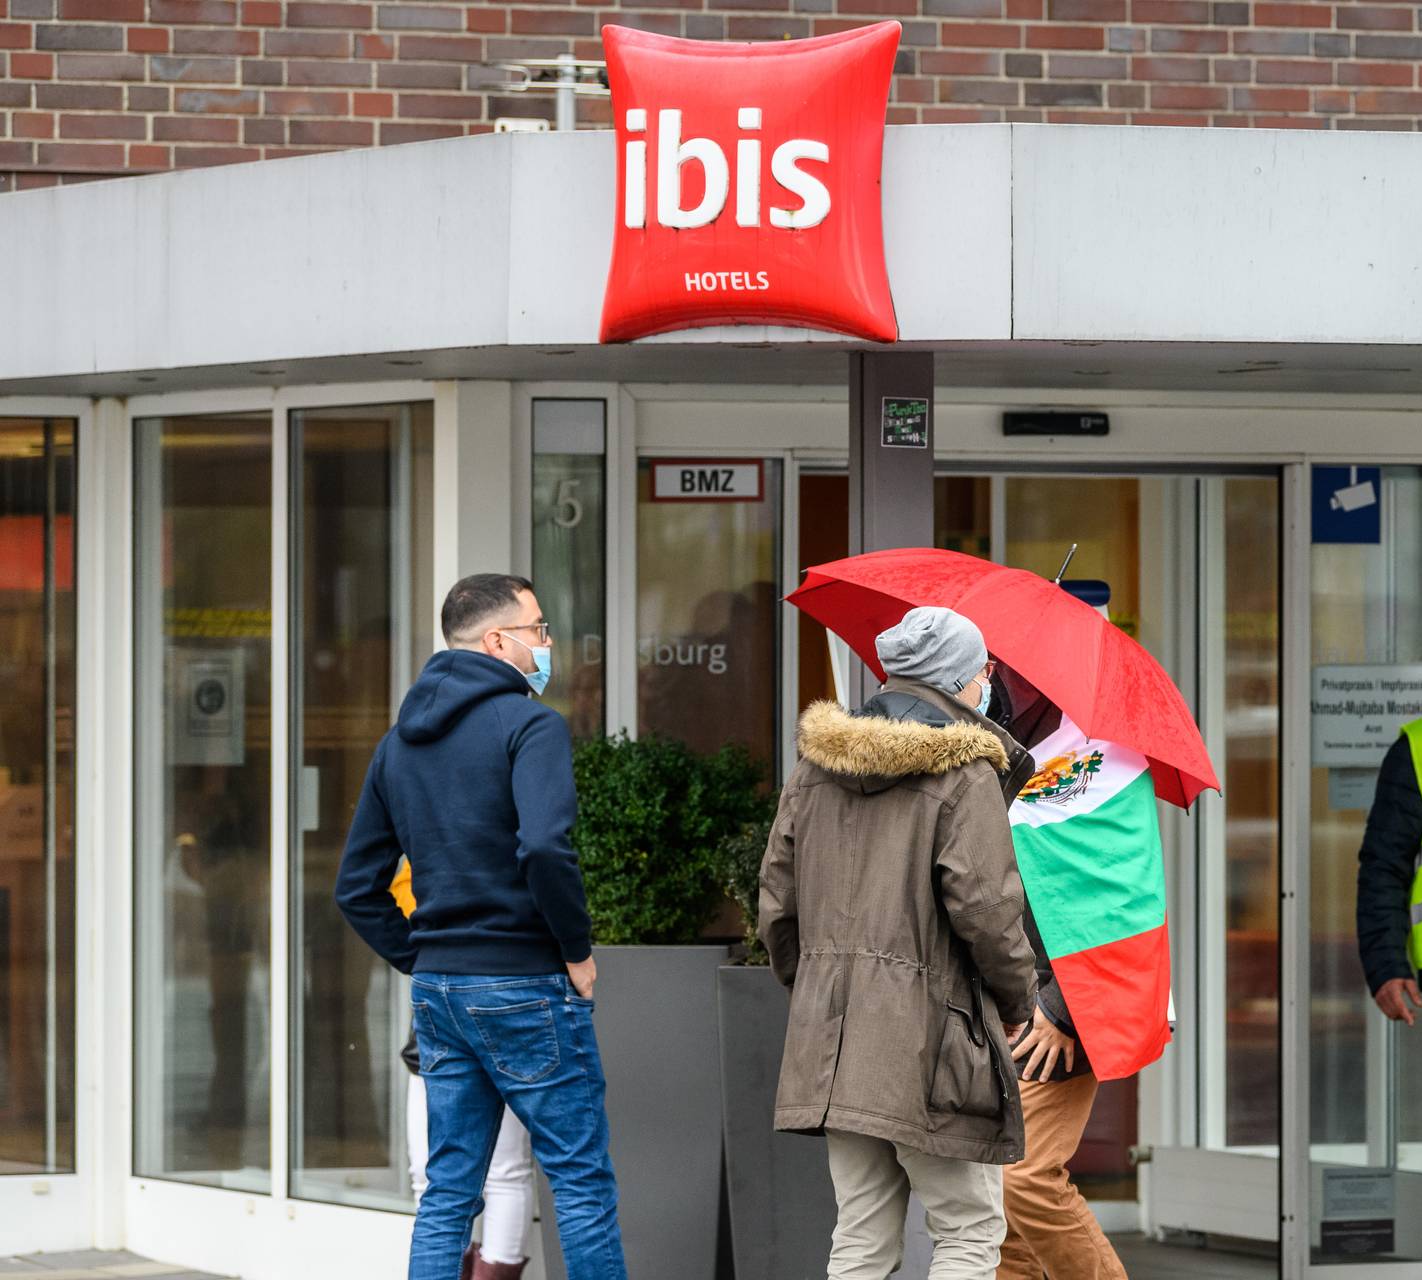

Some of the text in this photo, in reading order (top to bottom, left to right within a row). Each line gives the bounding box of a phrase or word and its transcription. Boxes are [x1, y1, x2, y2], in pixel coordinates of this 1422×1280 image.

[625, 107, 832, 229] ibis
[685, 271, 770, 292] HOTELS
[680, 469, 735, 493] BMZ
[583, 633, 728, 674] Dsburg
[1321, 679, 1373, 692] Privatpraxis
